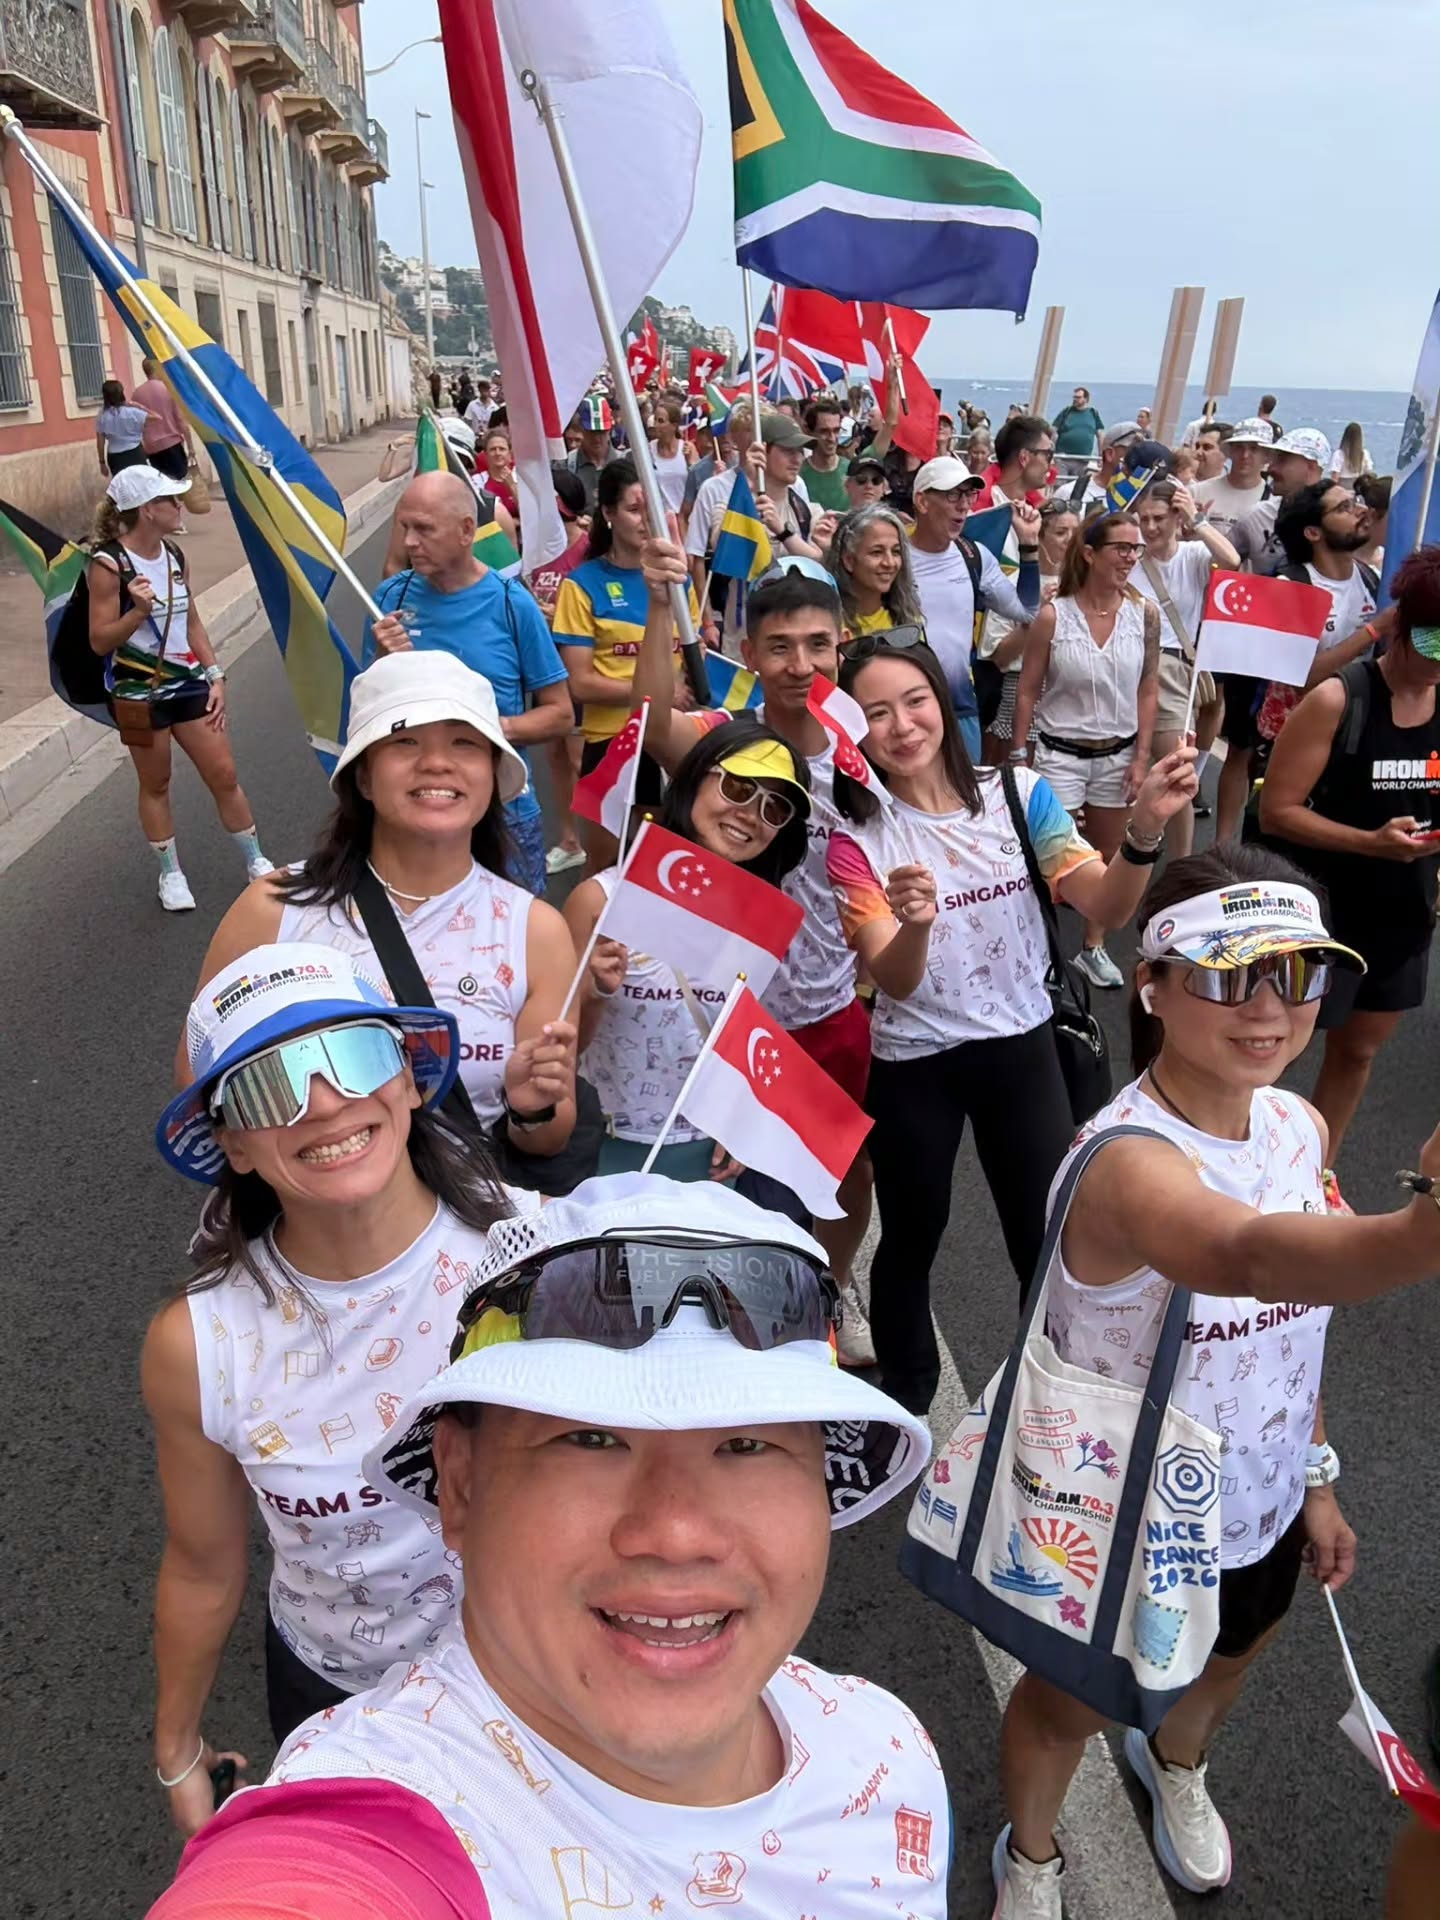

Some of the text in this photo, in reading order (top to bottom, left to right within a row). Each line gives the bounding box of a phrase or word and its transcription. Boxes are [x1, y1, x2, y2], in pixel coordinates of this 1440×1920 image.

[1372, 781, 1406, 790] WORLD
[1225, 908, 1313, 923] WORLD CHAMPIONSHIP
[219, 997, 249, 1024] WORLD
[252, 974, 333, 999] CHAMPIONSHIP
[623, 984, 671, 1000] TEAM
[1184, 1318, 1250, 1344] TEAM
[260, 1488, 350, 1518] TEAM
[1034, 1499, 1112, 1524] CHAMPIONSHIP
[1081, 1495, 1114, 1516] 70.3
[1143, 1545, 1219, 1570] FRANCE
[1149, 1567, 1218, 1594] 2026
[840, 1762, 889, 1819] singapore
